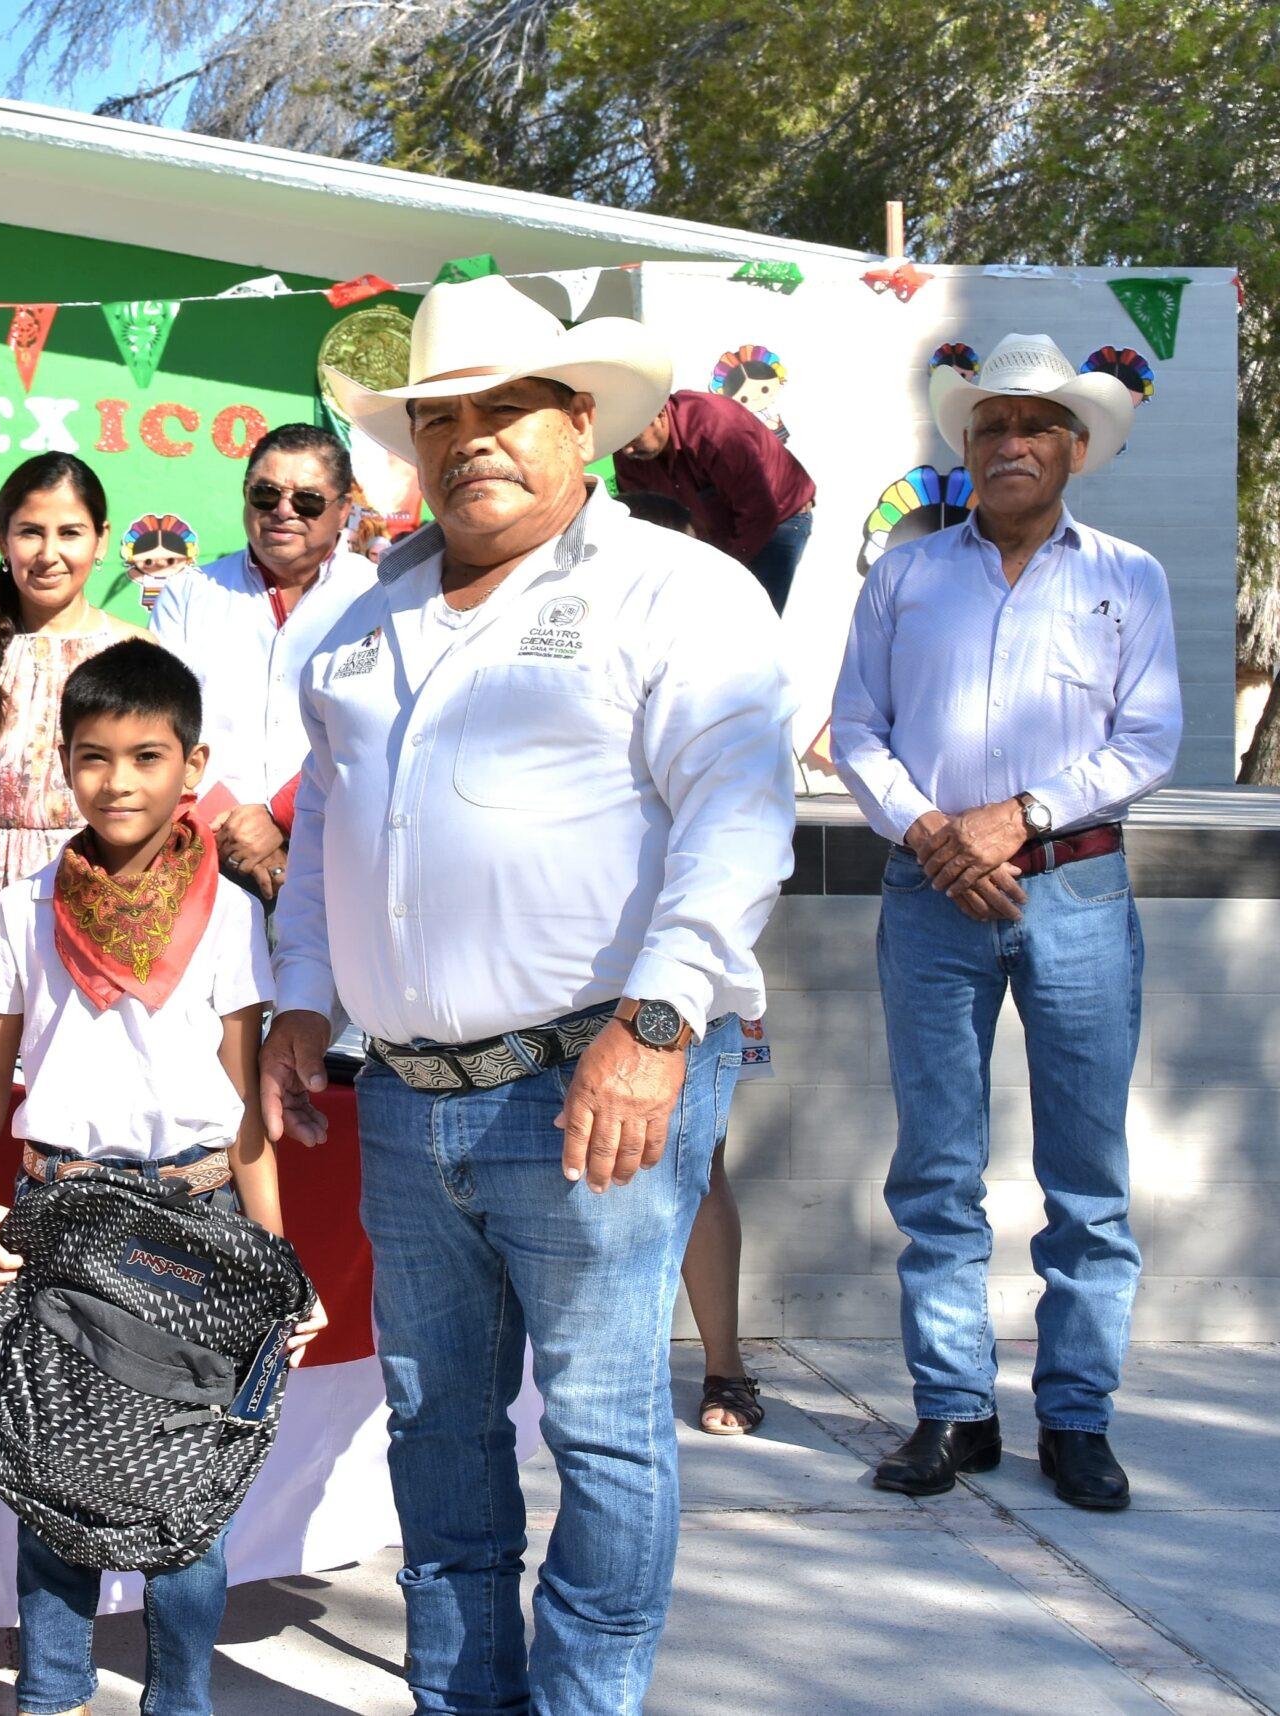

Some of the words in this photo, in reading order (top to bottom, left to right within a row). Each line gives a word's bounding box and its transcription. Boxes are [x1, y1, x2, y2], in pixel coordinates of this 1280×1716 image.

[529, 627, 581, 639] CUATRO
[520, 637, 583, 649] CIENEGAS
[126, 1248, 206, 1287] JANSPORT
